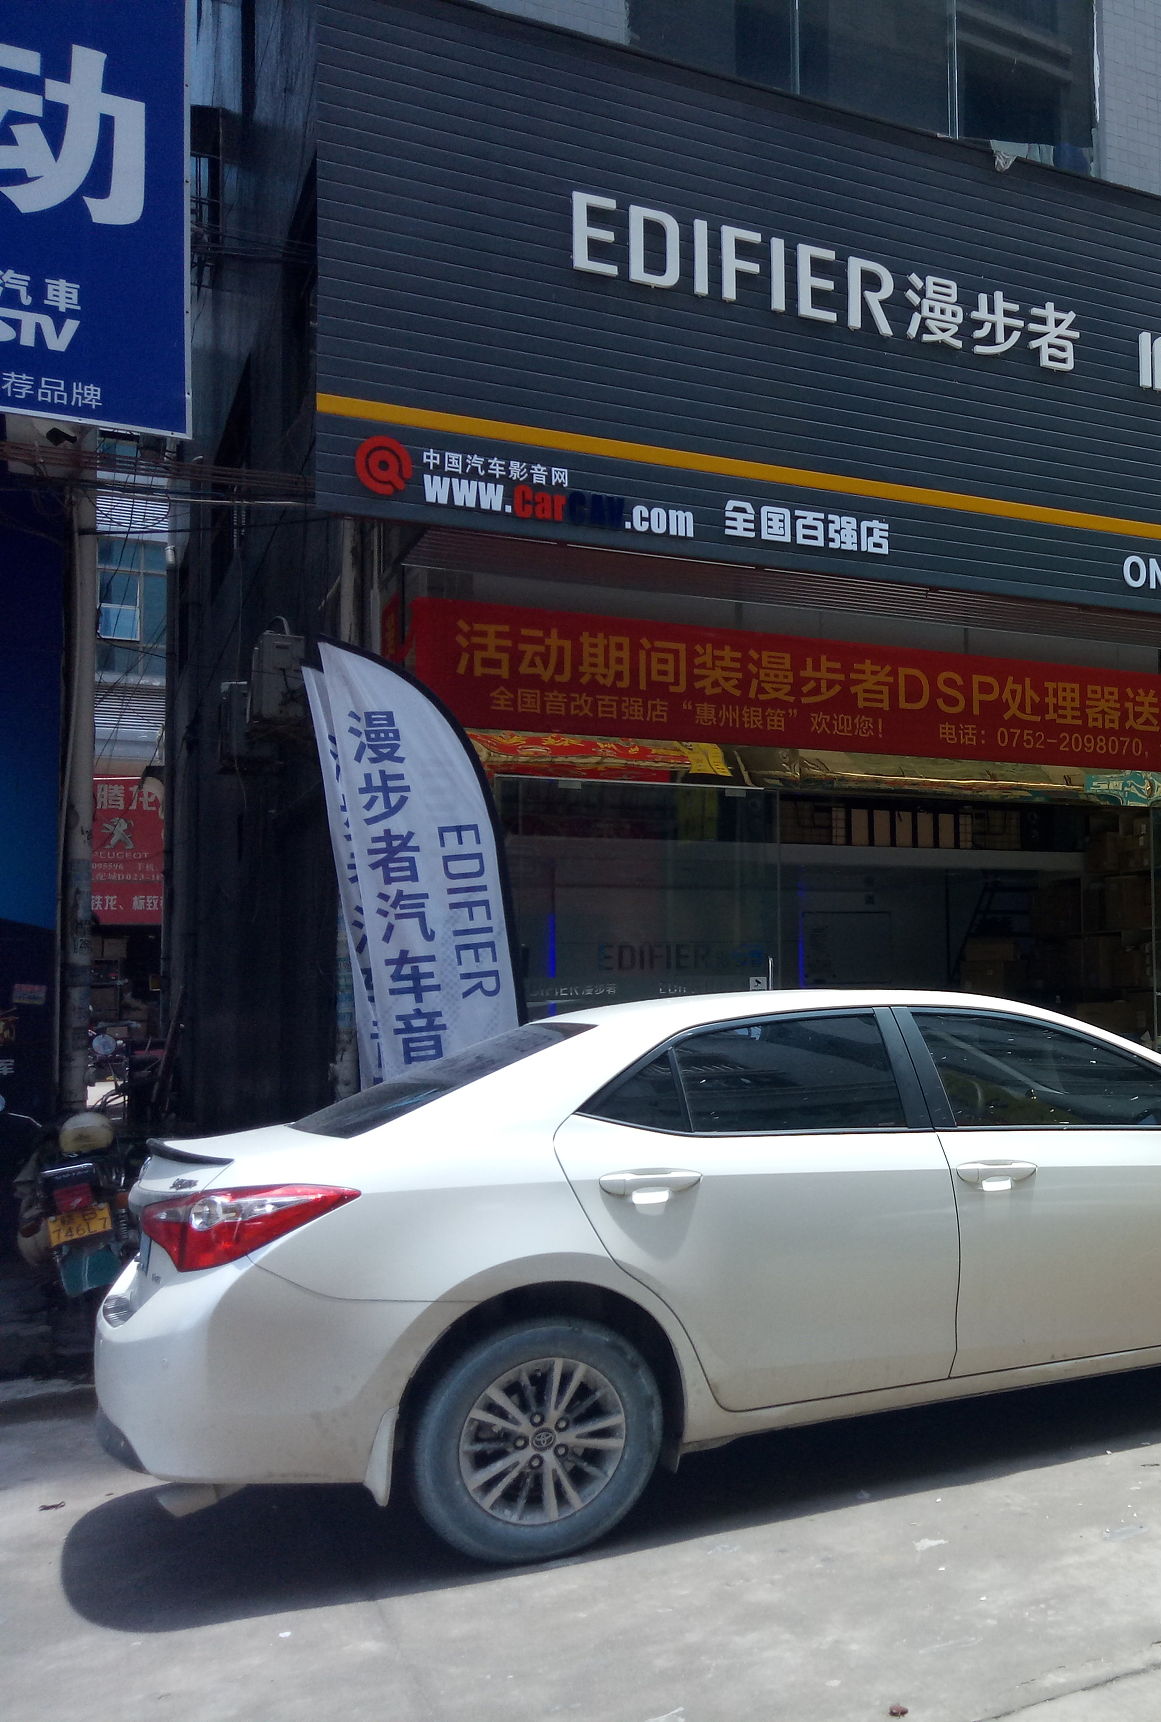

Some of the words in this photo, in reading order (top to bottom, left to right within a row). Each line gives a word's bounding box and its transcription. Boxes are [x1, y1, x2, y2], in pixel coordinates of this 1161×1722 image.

[0, 44, 145, 225] 动
[571, 191, 894, 337] EDIFIER
[905, 272, 1080, 372] 漫步者
[2, 371, 103, 408] 荐品牌
[422, 448, 569, 488] 中国汽车影音网
[724, 499, 889, 556] 全国百强店
[348, 709, 447, 1066] 漫步者汽车音
[437, 823, 501, 999] EDIFIER
